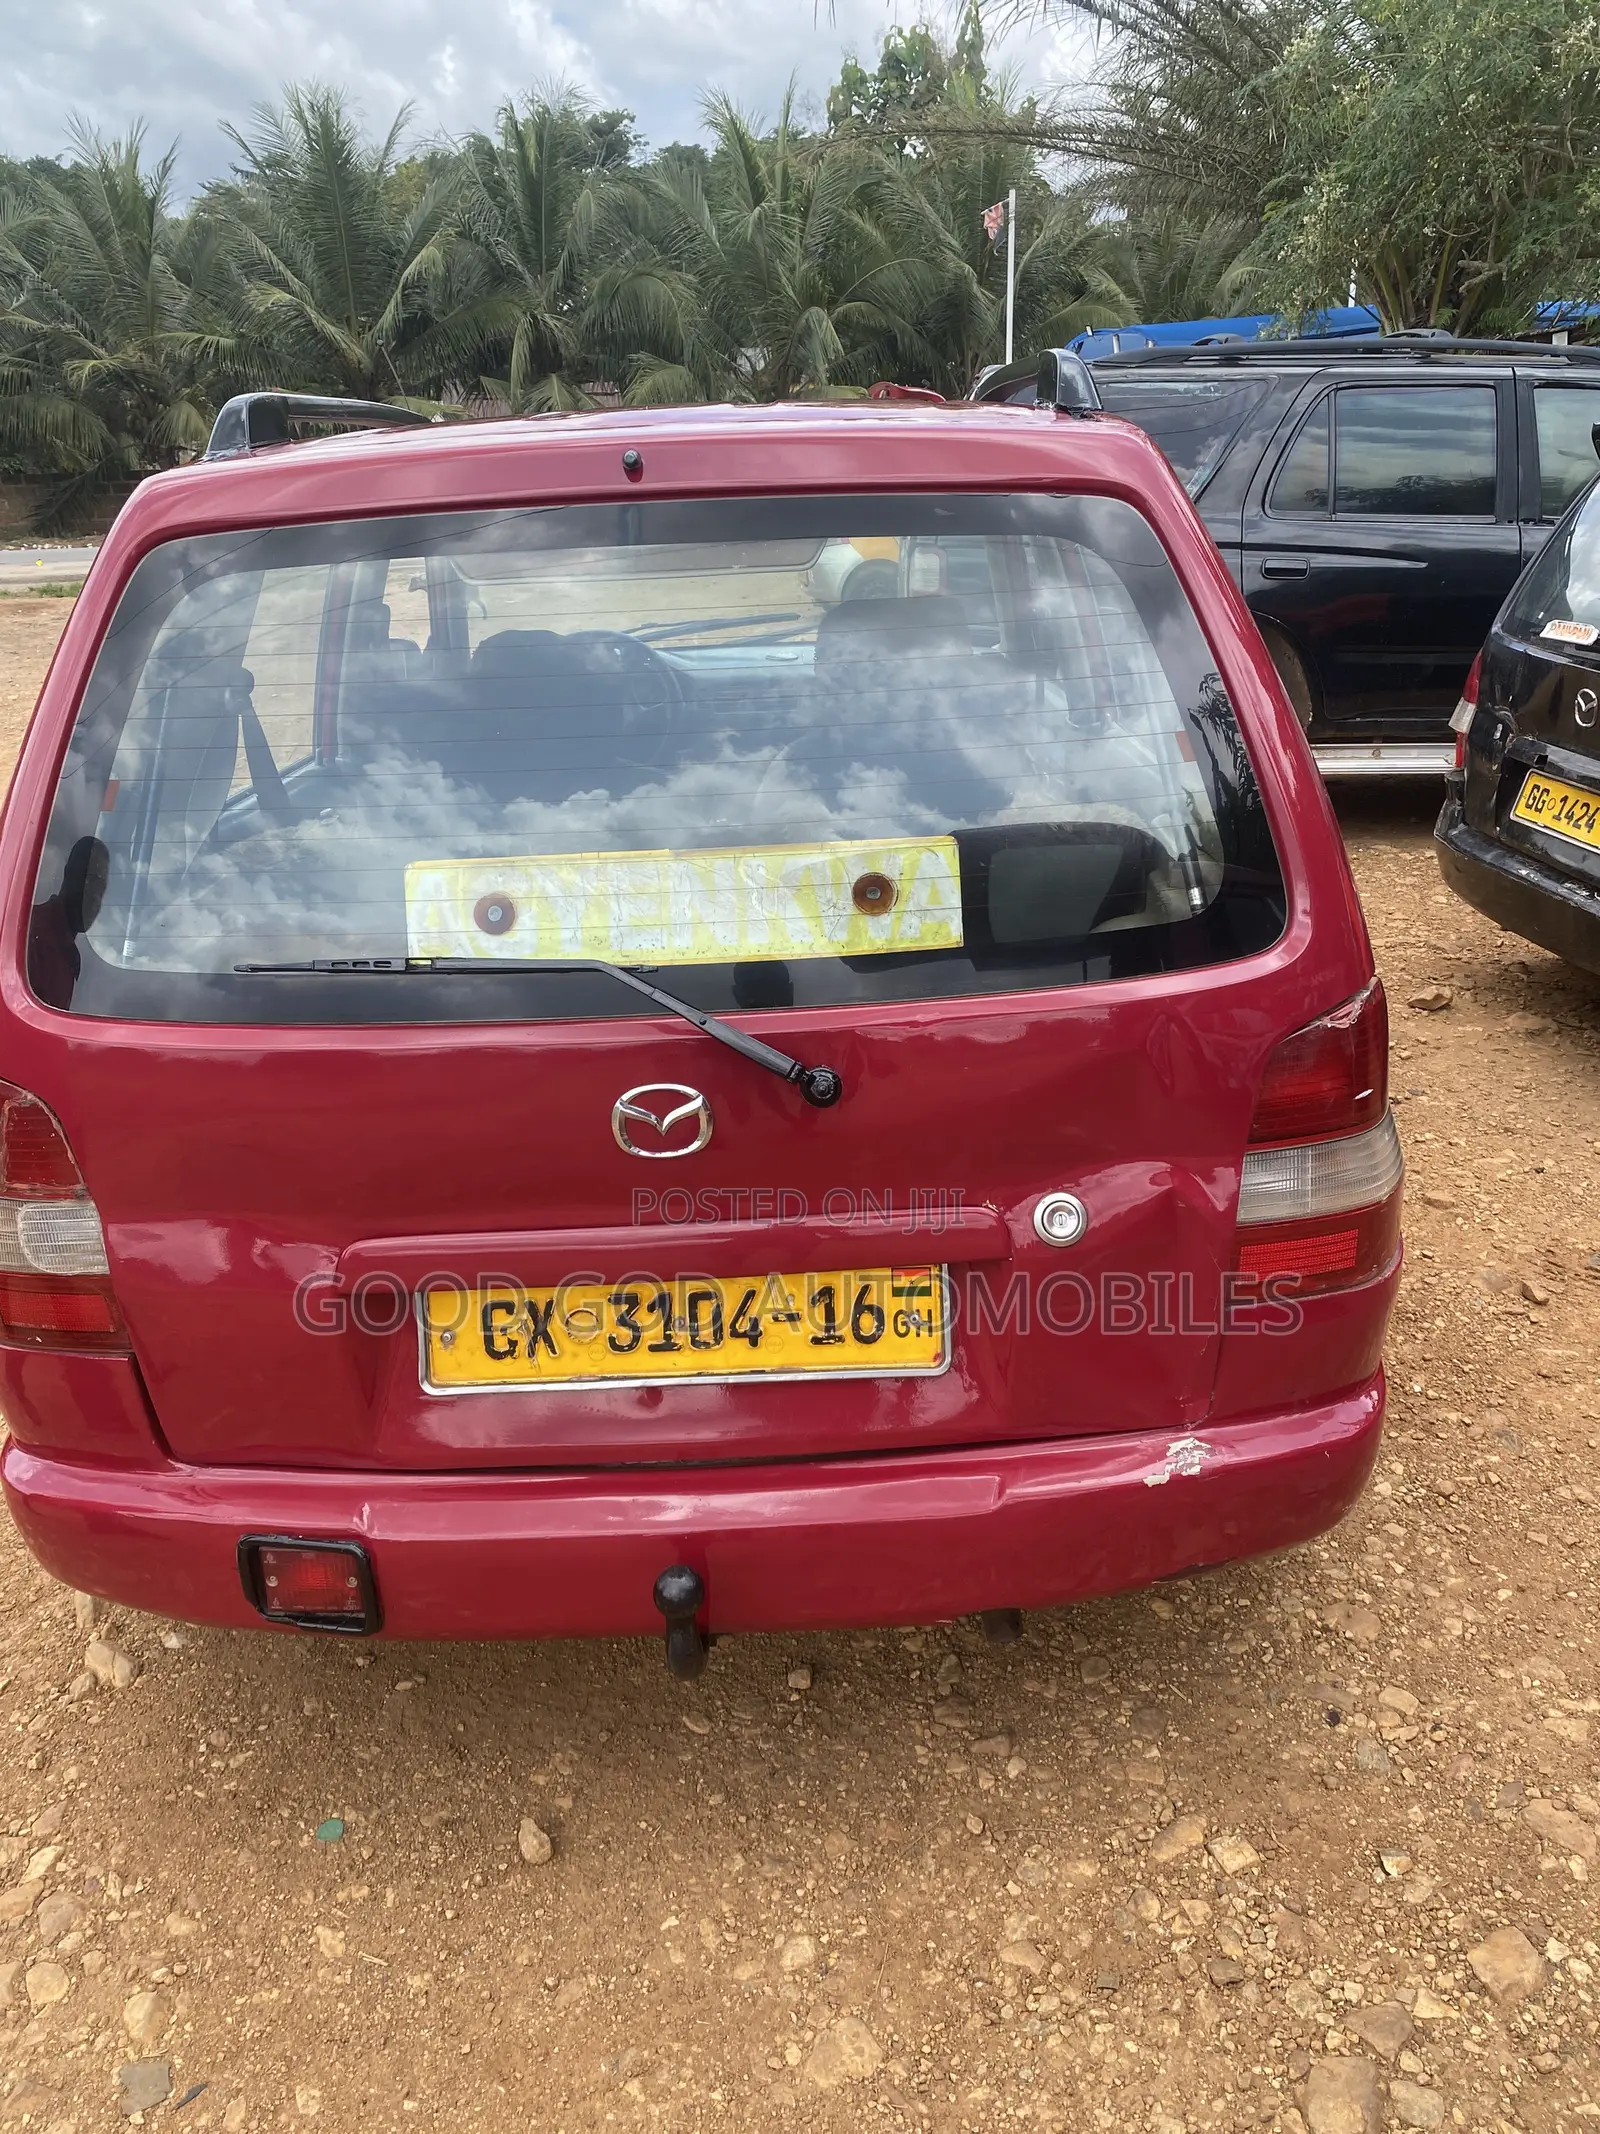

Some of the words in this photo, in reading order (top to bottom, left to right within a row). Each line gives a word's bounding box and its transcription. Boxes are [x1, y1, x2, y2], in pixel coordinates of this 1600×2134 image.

[1525, 783, 1550, 814] GG
[1552, 794, 1600, 834] 1424
[409, 850, 961, 957] AGYENKWA
[482, 1296, 561, 1361] GX
[893, 1308, 933, 1338] GH
